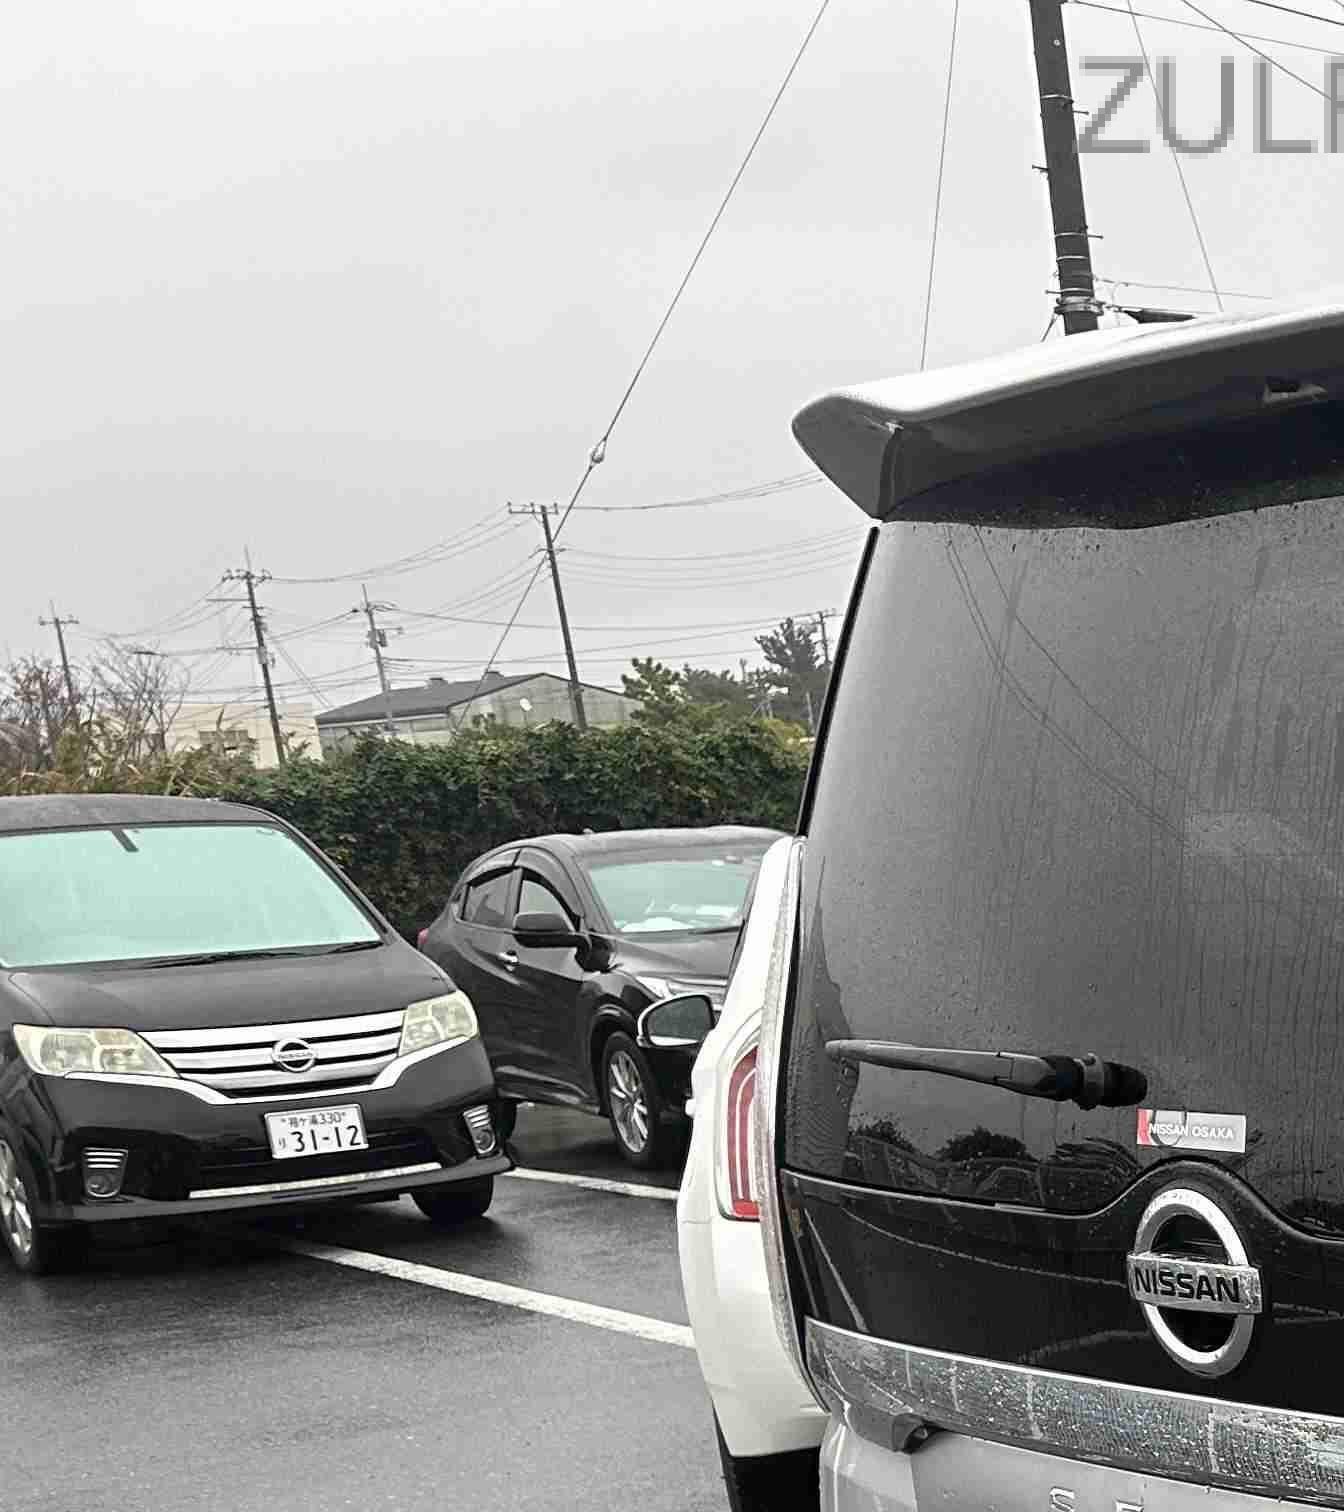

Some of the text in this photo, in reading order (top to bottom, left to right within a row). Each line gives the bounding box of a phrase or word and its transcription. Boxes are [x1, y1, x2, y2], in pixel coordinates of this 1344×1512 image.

[290, 1124, 361, 1152] 31-12
[1149, 1122, 1234, 1139] NISSAN OSAKA
[1133, 1269, 1241, 1304] NISSAN
